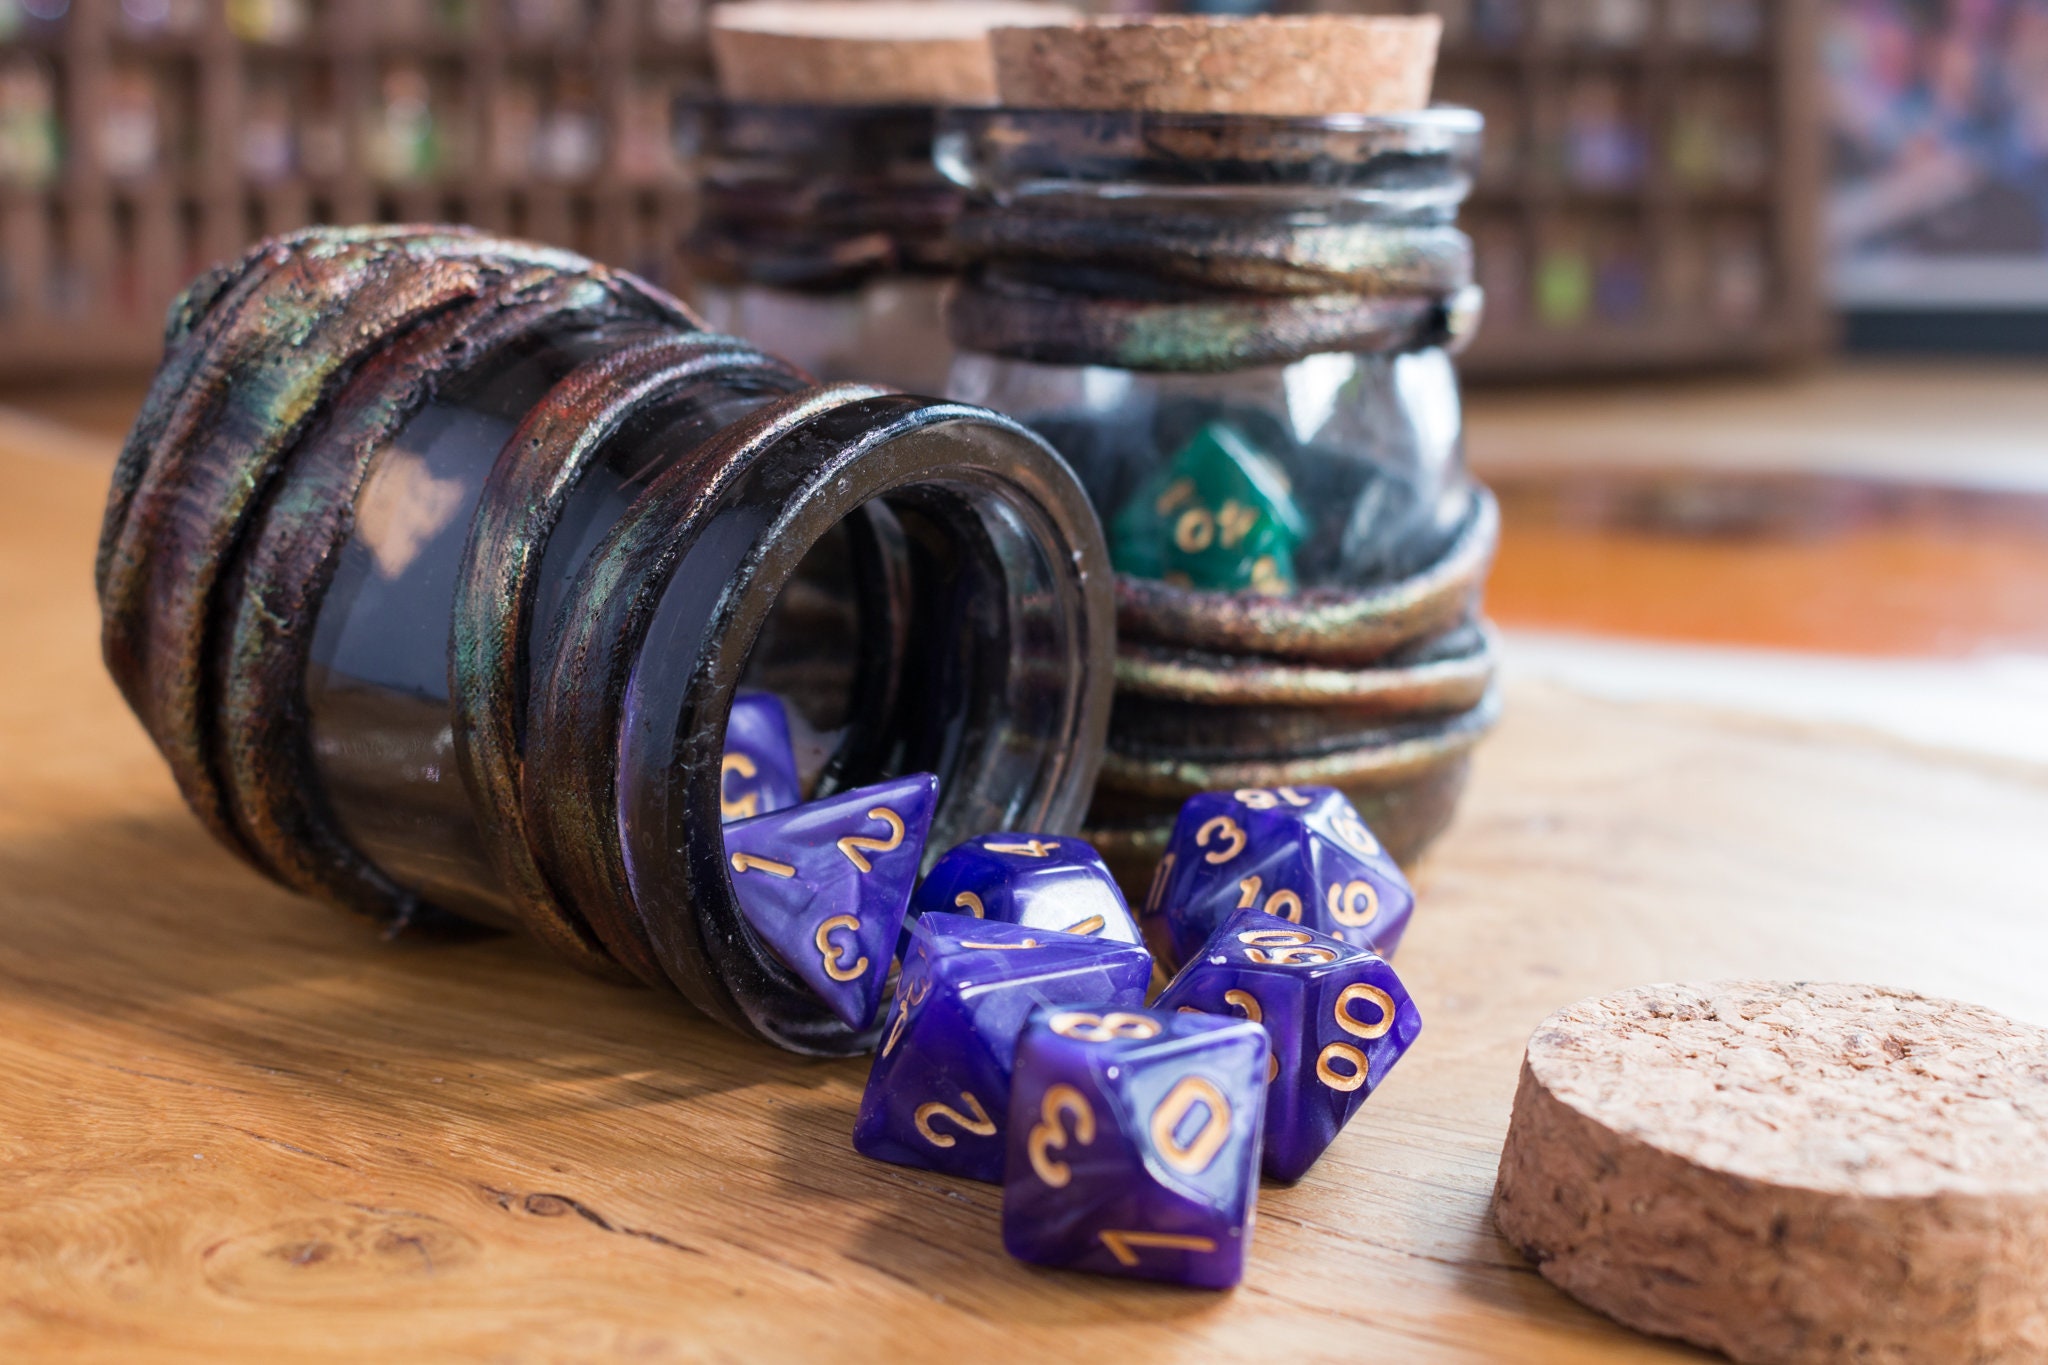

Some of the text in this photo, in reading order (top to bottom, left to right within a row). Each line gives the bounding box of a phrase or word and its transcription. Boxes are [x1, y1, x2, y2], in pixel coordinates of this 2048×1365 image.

[731, 852, 796, 879] 1
[837, 807, 906, 873] 2
[983, 839, 1061, 858] 4
[1196, 815, 1247, 865] 3
[816, 914, 869, 982] 3
[1047, 1012, 1163, 1043] 8
[1316, 982, 1396, 1092] 00
[913, 1091, 998, 1148] 2
[1027, 1083, 1097, 1189] 3
[1150, 1075, 1233, 1176] 0
